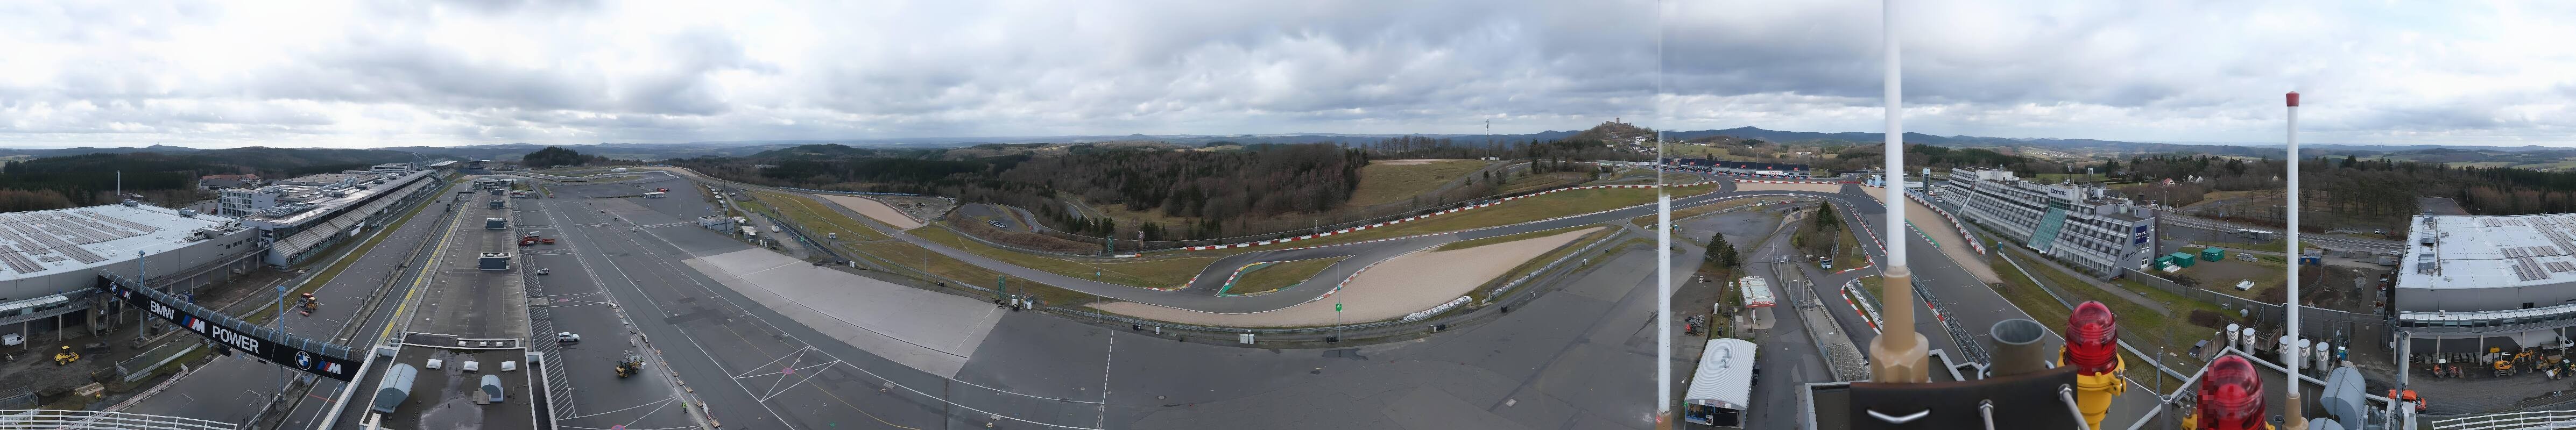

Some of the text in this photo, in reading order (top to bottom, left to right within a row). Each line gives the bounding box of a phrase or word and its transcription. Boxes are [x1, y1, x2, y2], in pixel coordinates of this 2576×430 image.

[151, 300, 259, 354] BMW M POWER
[327, 363, 341, 375] M
